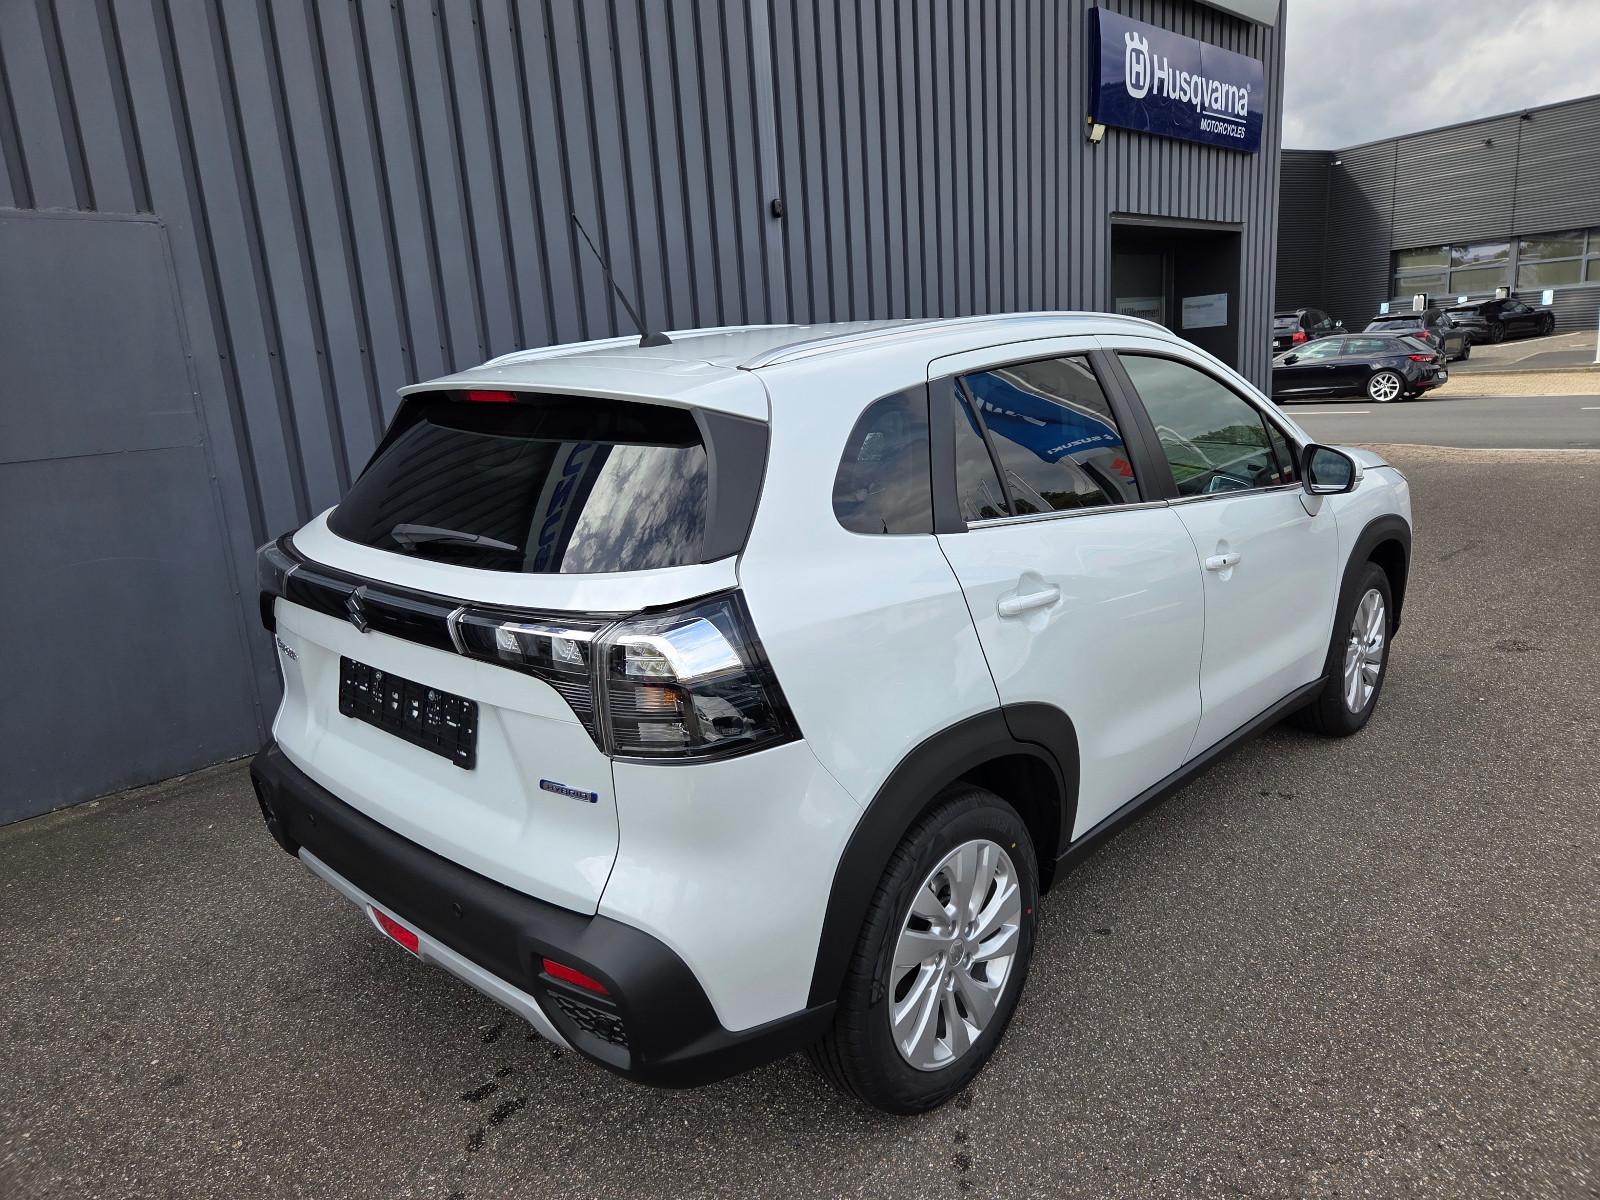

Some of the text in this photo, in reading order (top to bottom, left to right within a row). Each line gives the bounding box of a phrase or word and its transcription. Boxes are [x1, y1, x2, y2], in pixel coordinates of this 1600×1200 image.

[1153, 54, 1248, 117] Husqvarna
[1200, 118, 1246, 139] MOTORCYCLES
[541, 780, 592, 802] HYBRID
